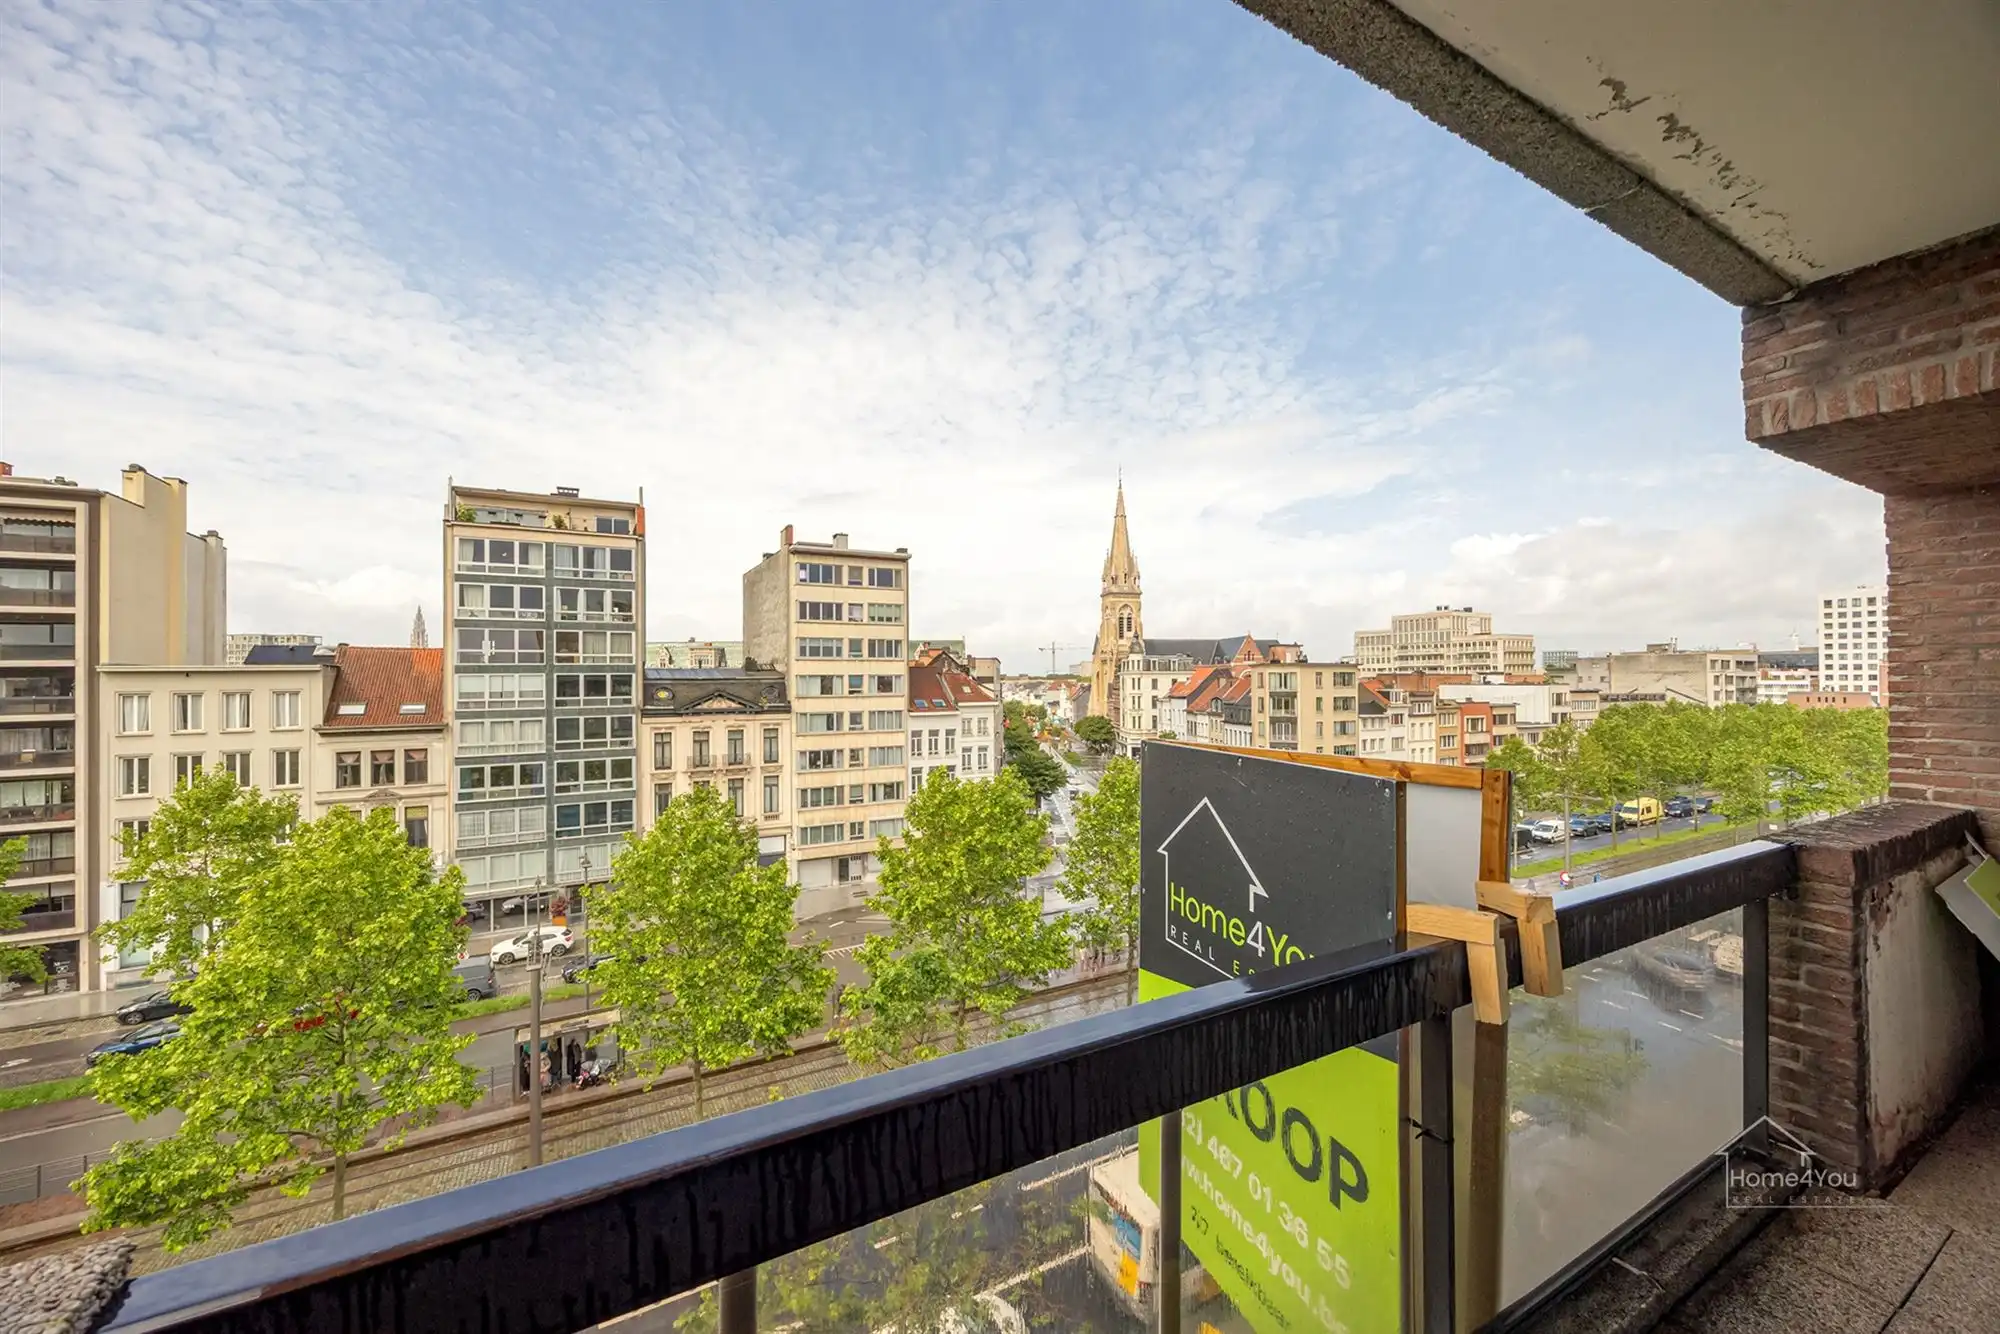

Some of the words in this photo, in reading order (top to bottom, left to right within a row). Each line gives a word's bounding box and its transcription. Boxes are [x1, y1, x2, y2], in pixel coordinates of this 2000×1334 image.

[1170, 881, 1315, 967] Home4Yo
[1170, 925, 1216, 962] REAL
[1214, 1080, 1370, 1213] OOP
[1207, 1135, 1243, 1180] 487
[1248, 1172, 1272, 1214] 01
[1317, 1237, 1351, 1290] 55
